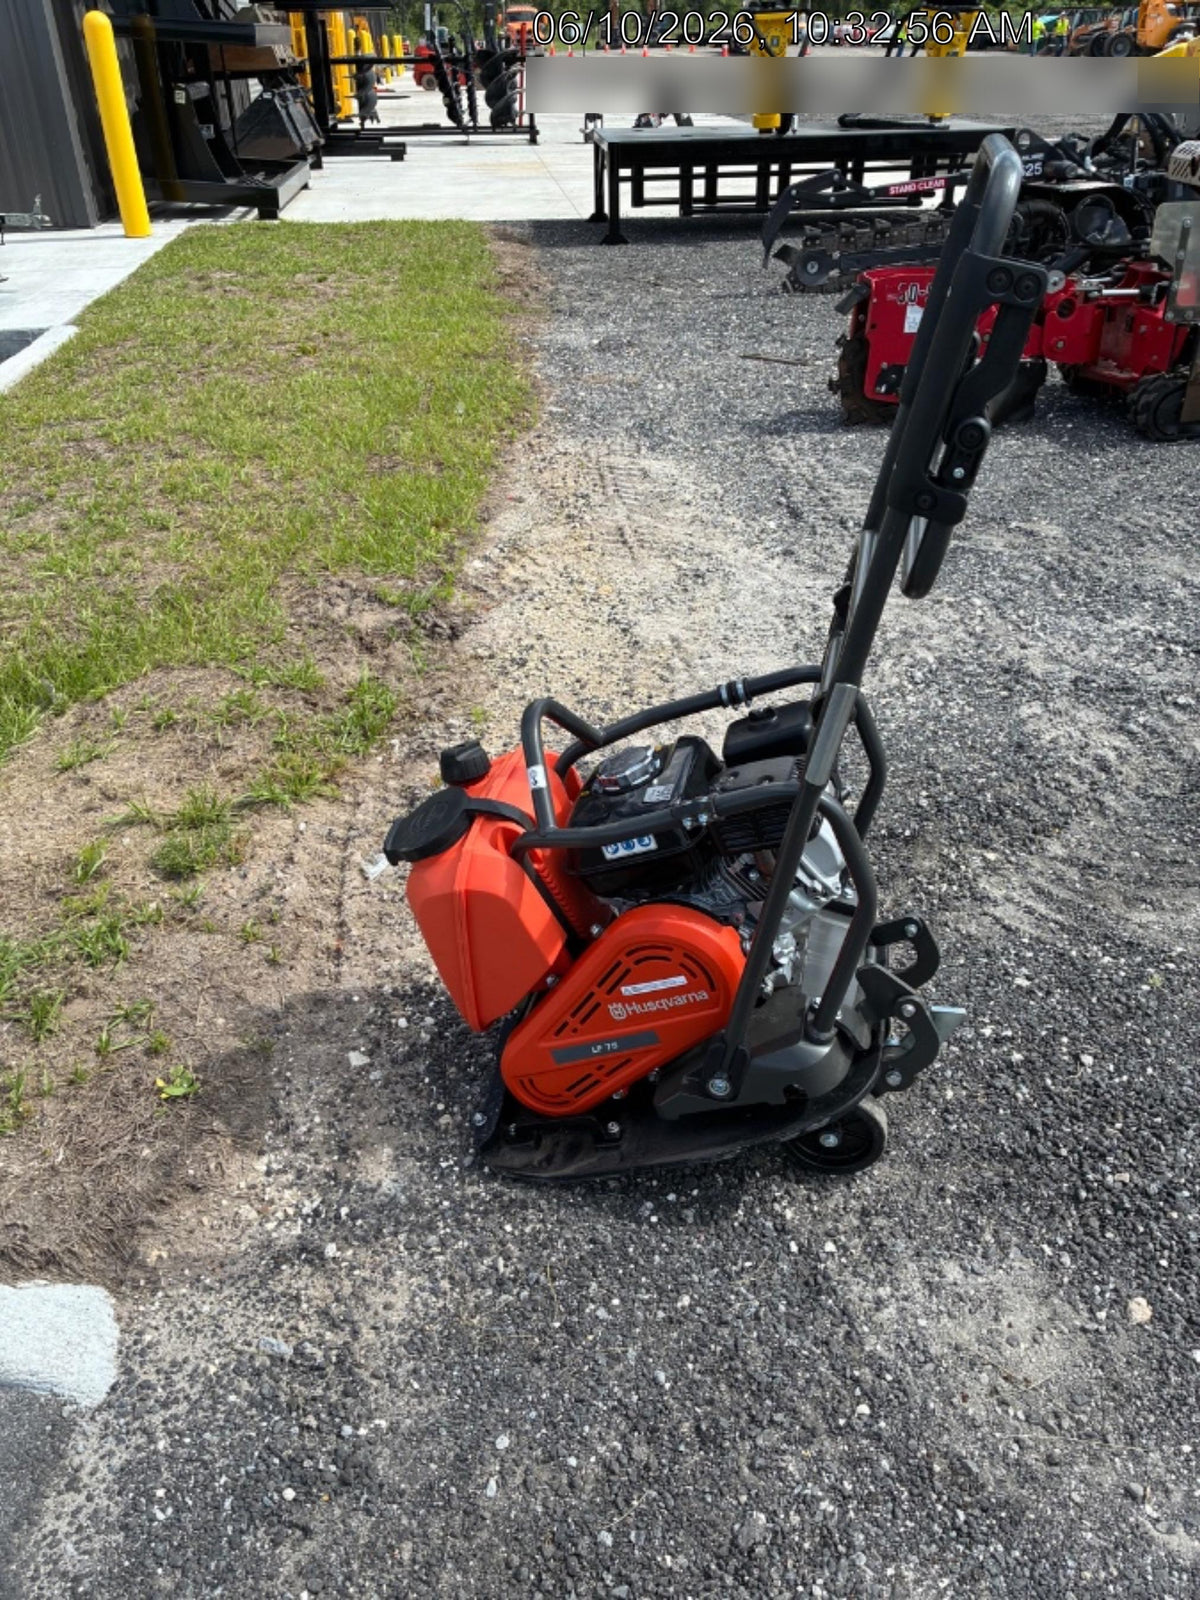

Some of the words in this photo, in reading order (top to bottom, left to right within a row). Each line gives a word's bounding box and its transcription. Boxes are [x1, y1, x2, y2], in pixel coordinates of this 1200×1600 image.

[889, 182, 916, 195] STAND
[918, 179, 945, 190] CLEAR
[625, 990, 709, 1015] Husqvarna
